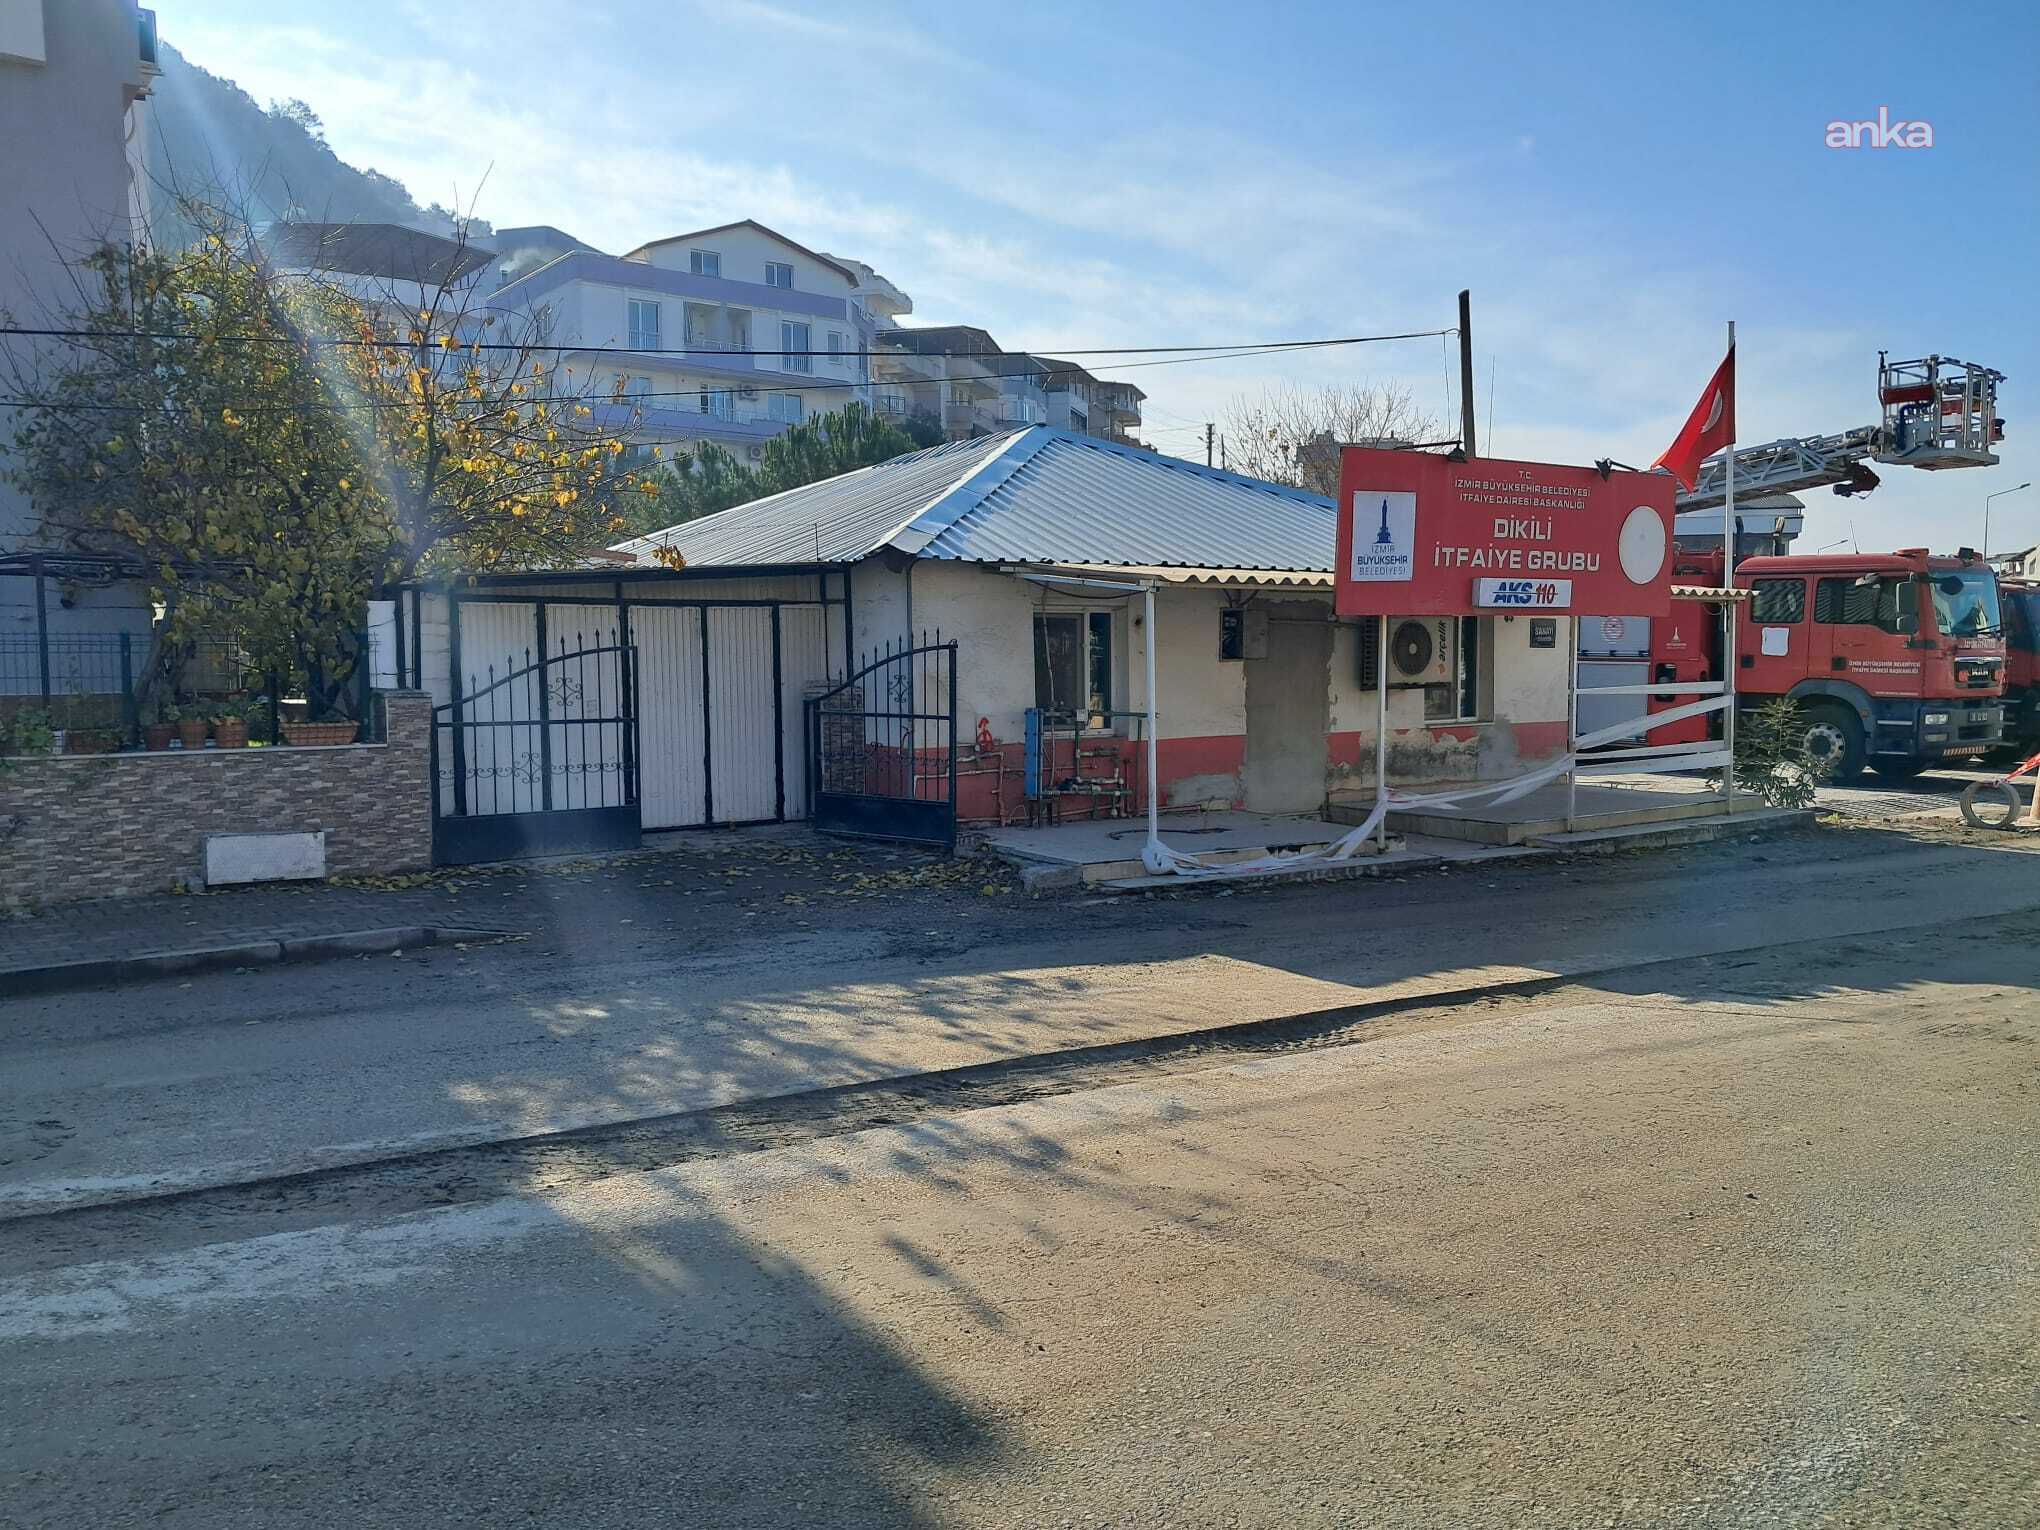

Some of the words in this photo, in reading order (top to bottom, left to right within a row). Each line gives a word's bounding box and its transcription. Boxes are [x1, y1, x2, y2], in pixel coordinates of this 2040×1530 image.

[1493, 514, 1552, 541] DİKİLİ
[1433, 541, 1522, 569] İTFAİYE
[1527, 550, 1601, 572] GRUBU
[1493, 582, 1533, 605] AKS
[1535, 583, 1558, 605] 110
